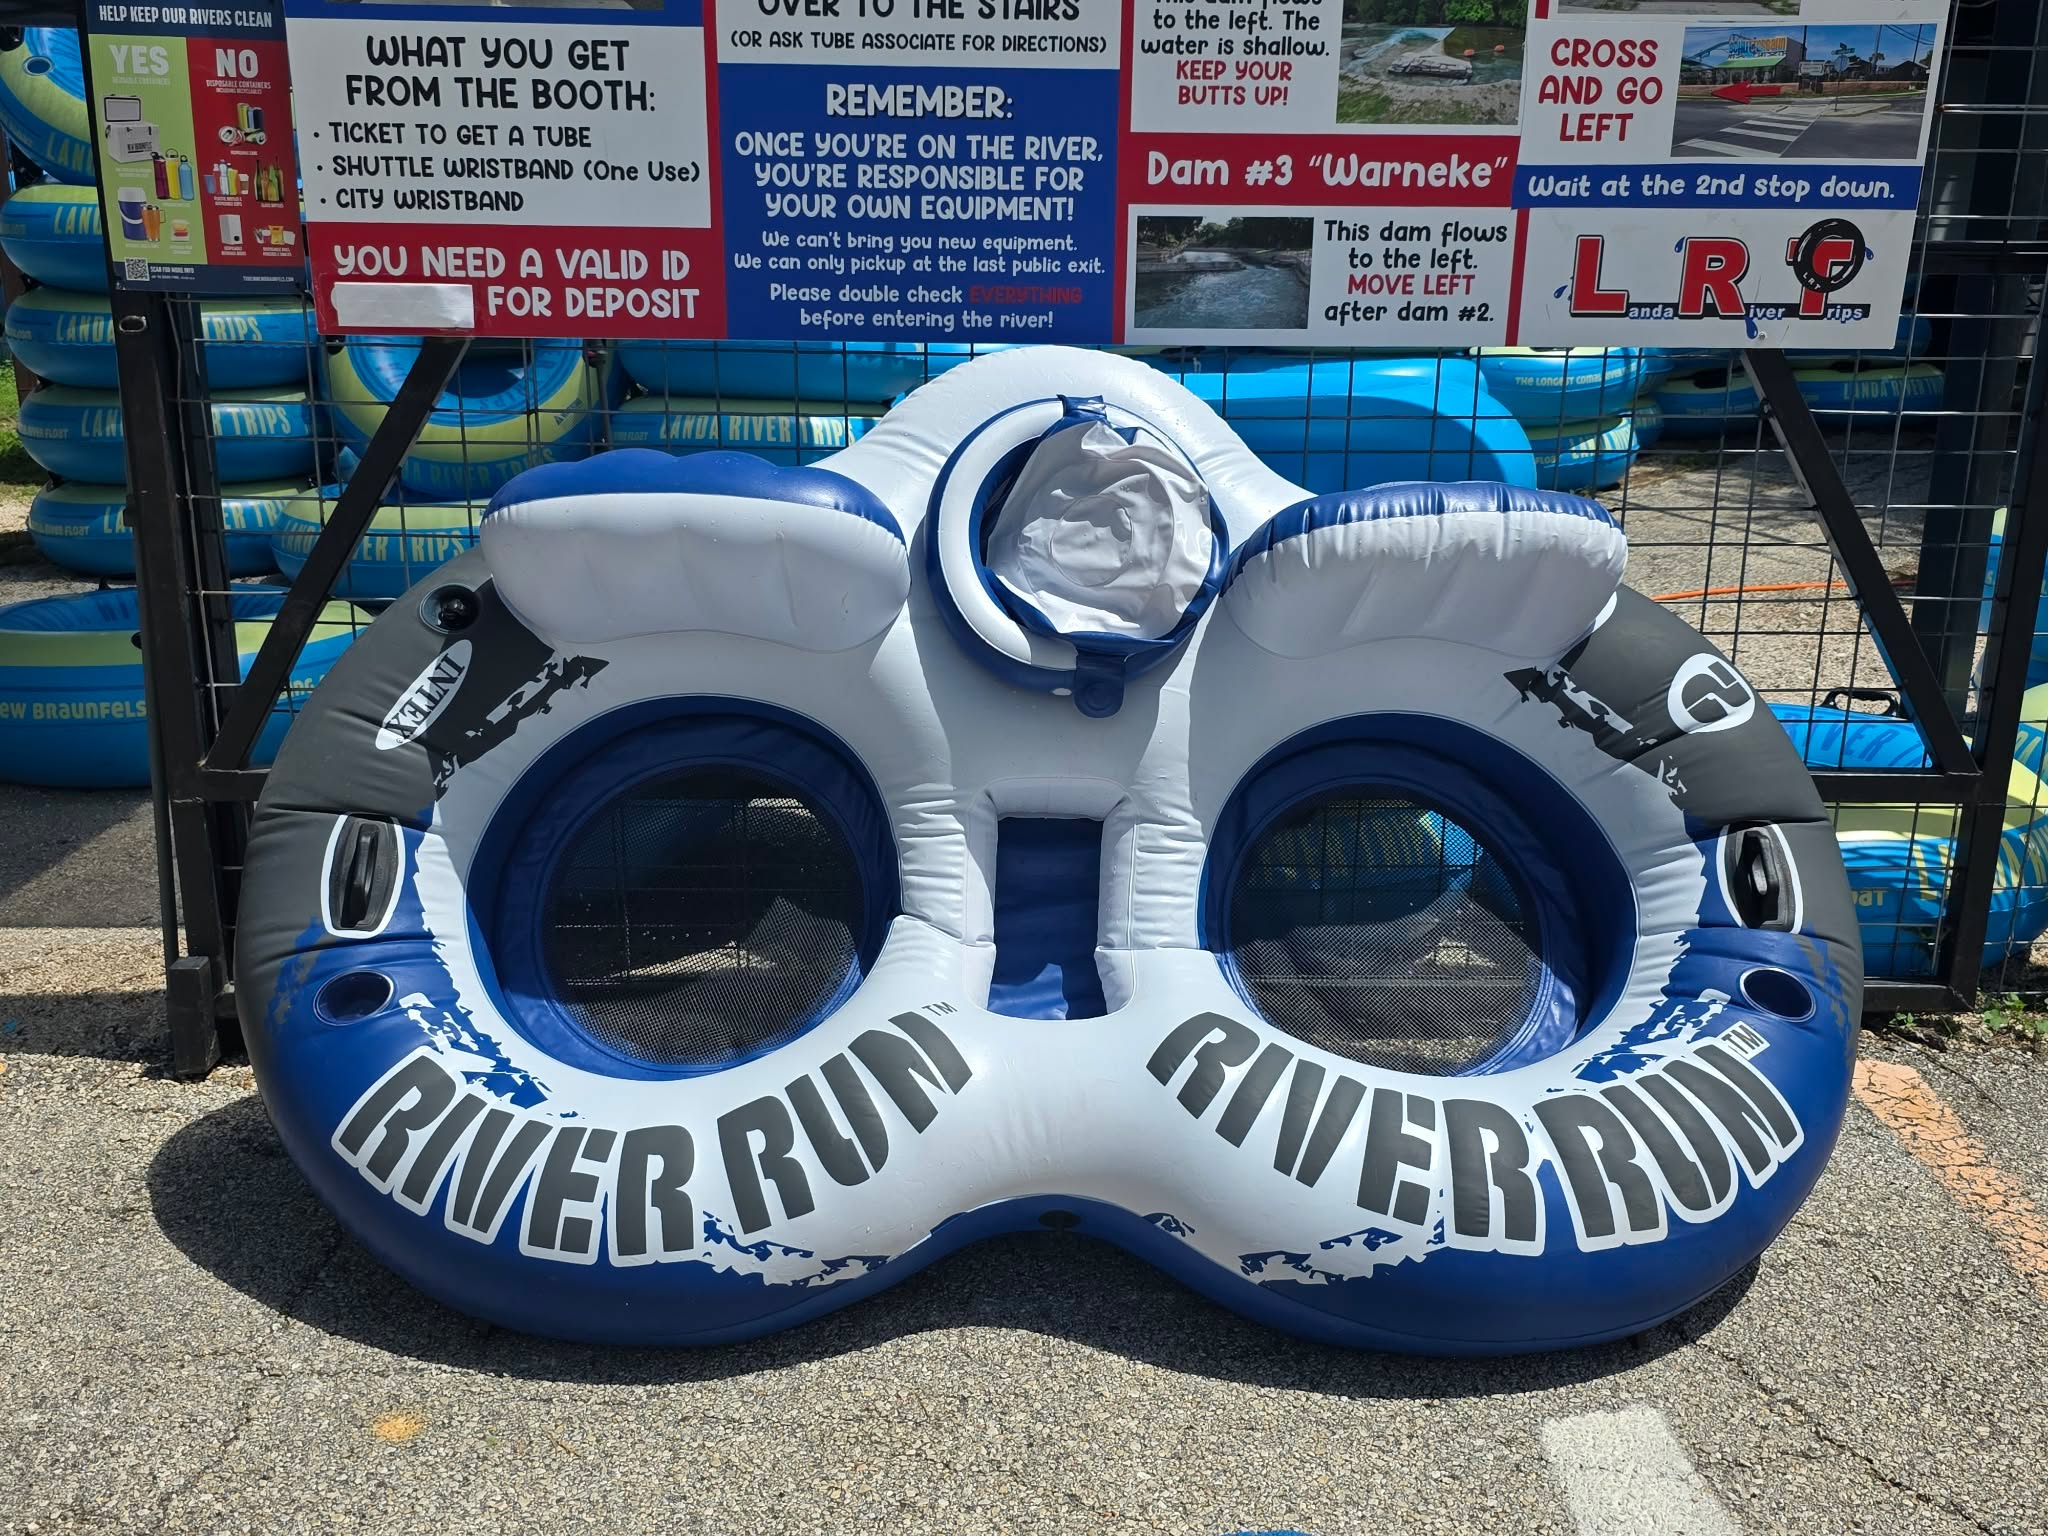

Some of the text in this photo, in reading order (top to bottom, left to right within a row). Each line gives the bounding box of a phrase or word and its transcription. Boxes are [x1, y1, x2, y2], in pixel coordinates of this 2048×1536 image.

[99, 5, 272, 28] HELP KEEP OUR RIVERS CLEAN
[1153, 9, 1320, 35] to the left. The
[366, 35, 630, 71] WHAT YOU GET
[731, 31, 1107, 54] (OR ASK TUBE ASSOCIATE FOR DIRECTIONS)
[1140, 35, 1330, 56] water is shallow.
[1550, 38, 1658, 68] CROSS
[109, 45, 169, 76] YES
[215, 48, 259, 78] NO
[1176, 60, 1293, 82] KEEP YOUR
[345, 74, 655, 112] FROM THE BOOTH:
[826, 83, 1014, 119] REMEMBER:
[1178, 85, 1289, 106] BUTTS UP!
[1538, 76, 1663, 105] AND GO
[329, 121, 592, 147] TICKET TO GET A TUBE
[1559, 113, 1634, 142] LEFT
[735, 131, 1103, 162] ONCE YOU'RE ON THE RIVER,
[332, 155, 700, 183] SHUTTLE WRISTBAND (One Use)
[755, 162, 1084, 192] YOU'RE RESPONSIBLE FOR
[1147, 151, 1230, 186] Dam
[1244, 154, 1293, 187] #3
[335, 188, 524, 212] CITY WRISTBAND
[1528, 173, 1895, 203] Wait at the 2nd stop down.
[765, 193, 1075, 221] YOUR OWN EQUIPMENT!
[762, 231, 1077, 256] We can't bring you new equipment.
[1324, 220, 1508, 247] This dam flows
[334, 245, 690, 280] YOU NEED A VALID ID
[734, 253, 1105, 276] We can only pickup at the last public exit.
[1348, 248, 1478, 274] to the left.
[770, 282, 1083, 304] Please double check EVERYTHING
[1347, 274, 1476, 295] MOVE LEFT
[488, 286, 700, 319] FOR DEPOSIT
[1324, 302, 1495, 326] after dam #2.
[800, 308, 1053, 332] before entering the river!
[231, 405, 292, 436] TRIPS
[728, 415, 792, 444] RIVER
[383, 653, 466, 739] INTEX
[338, 1053, 696, 1258] RIVER
[717, 1010, 974, 1235] RUN
[1145, 1011, 1538, 1244] RIVER
[1532, 1044, 1798, 1240] RUN
